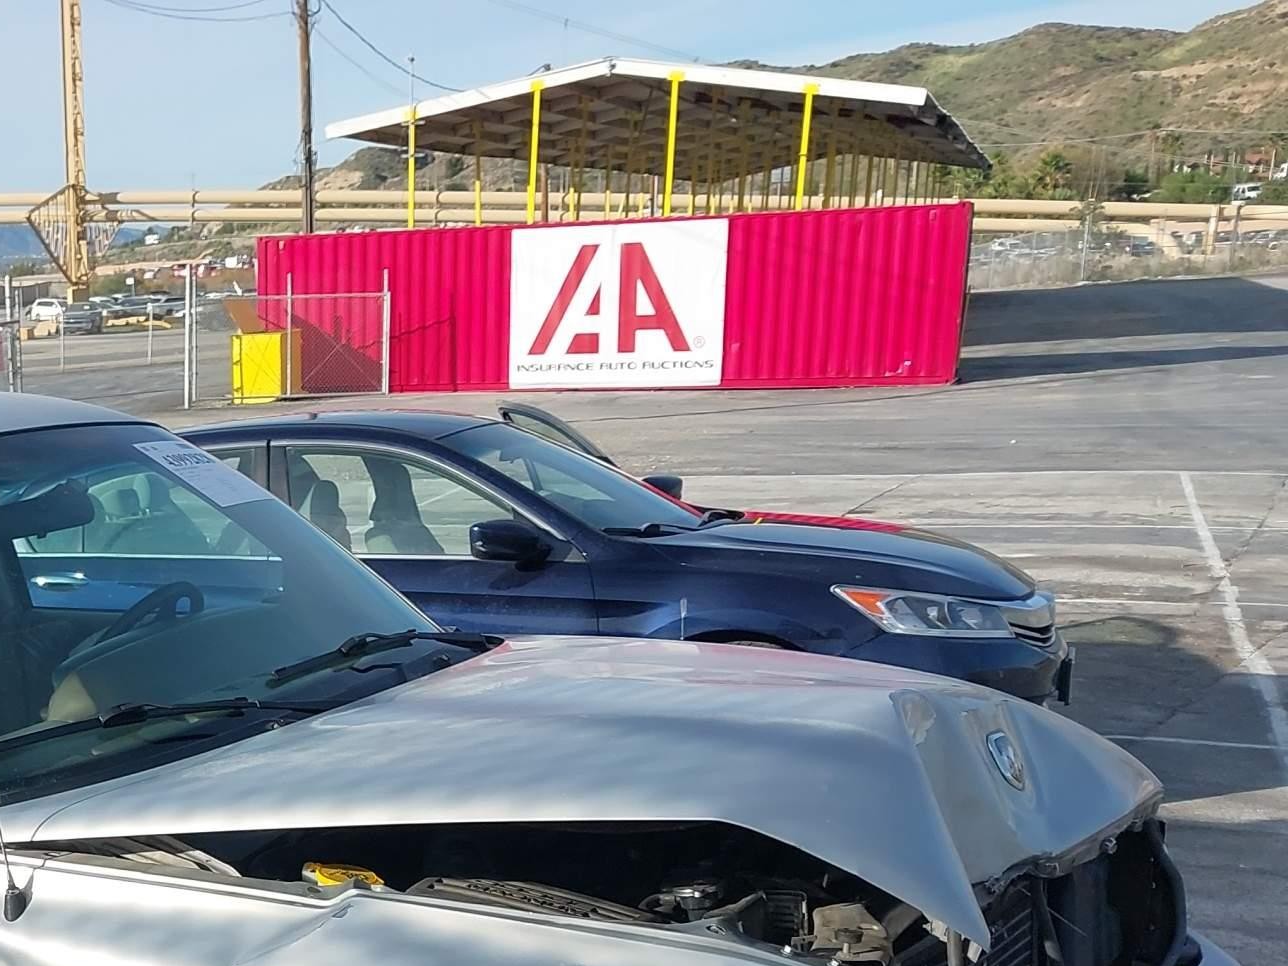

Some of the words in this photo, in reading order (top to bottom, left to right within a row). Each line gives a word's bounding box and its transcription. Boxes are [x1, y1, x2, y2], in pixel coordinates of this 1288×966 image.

[516, 361, 593, 372] INSURANCE
[599, 361, 637, 370] AUTO
[642, 360, 714, 370] AUCTIONS
